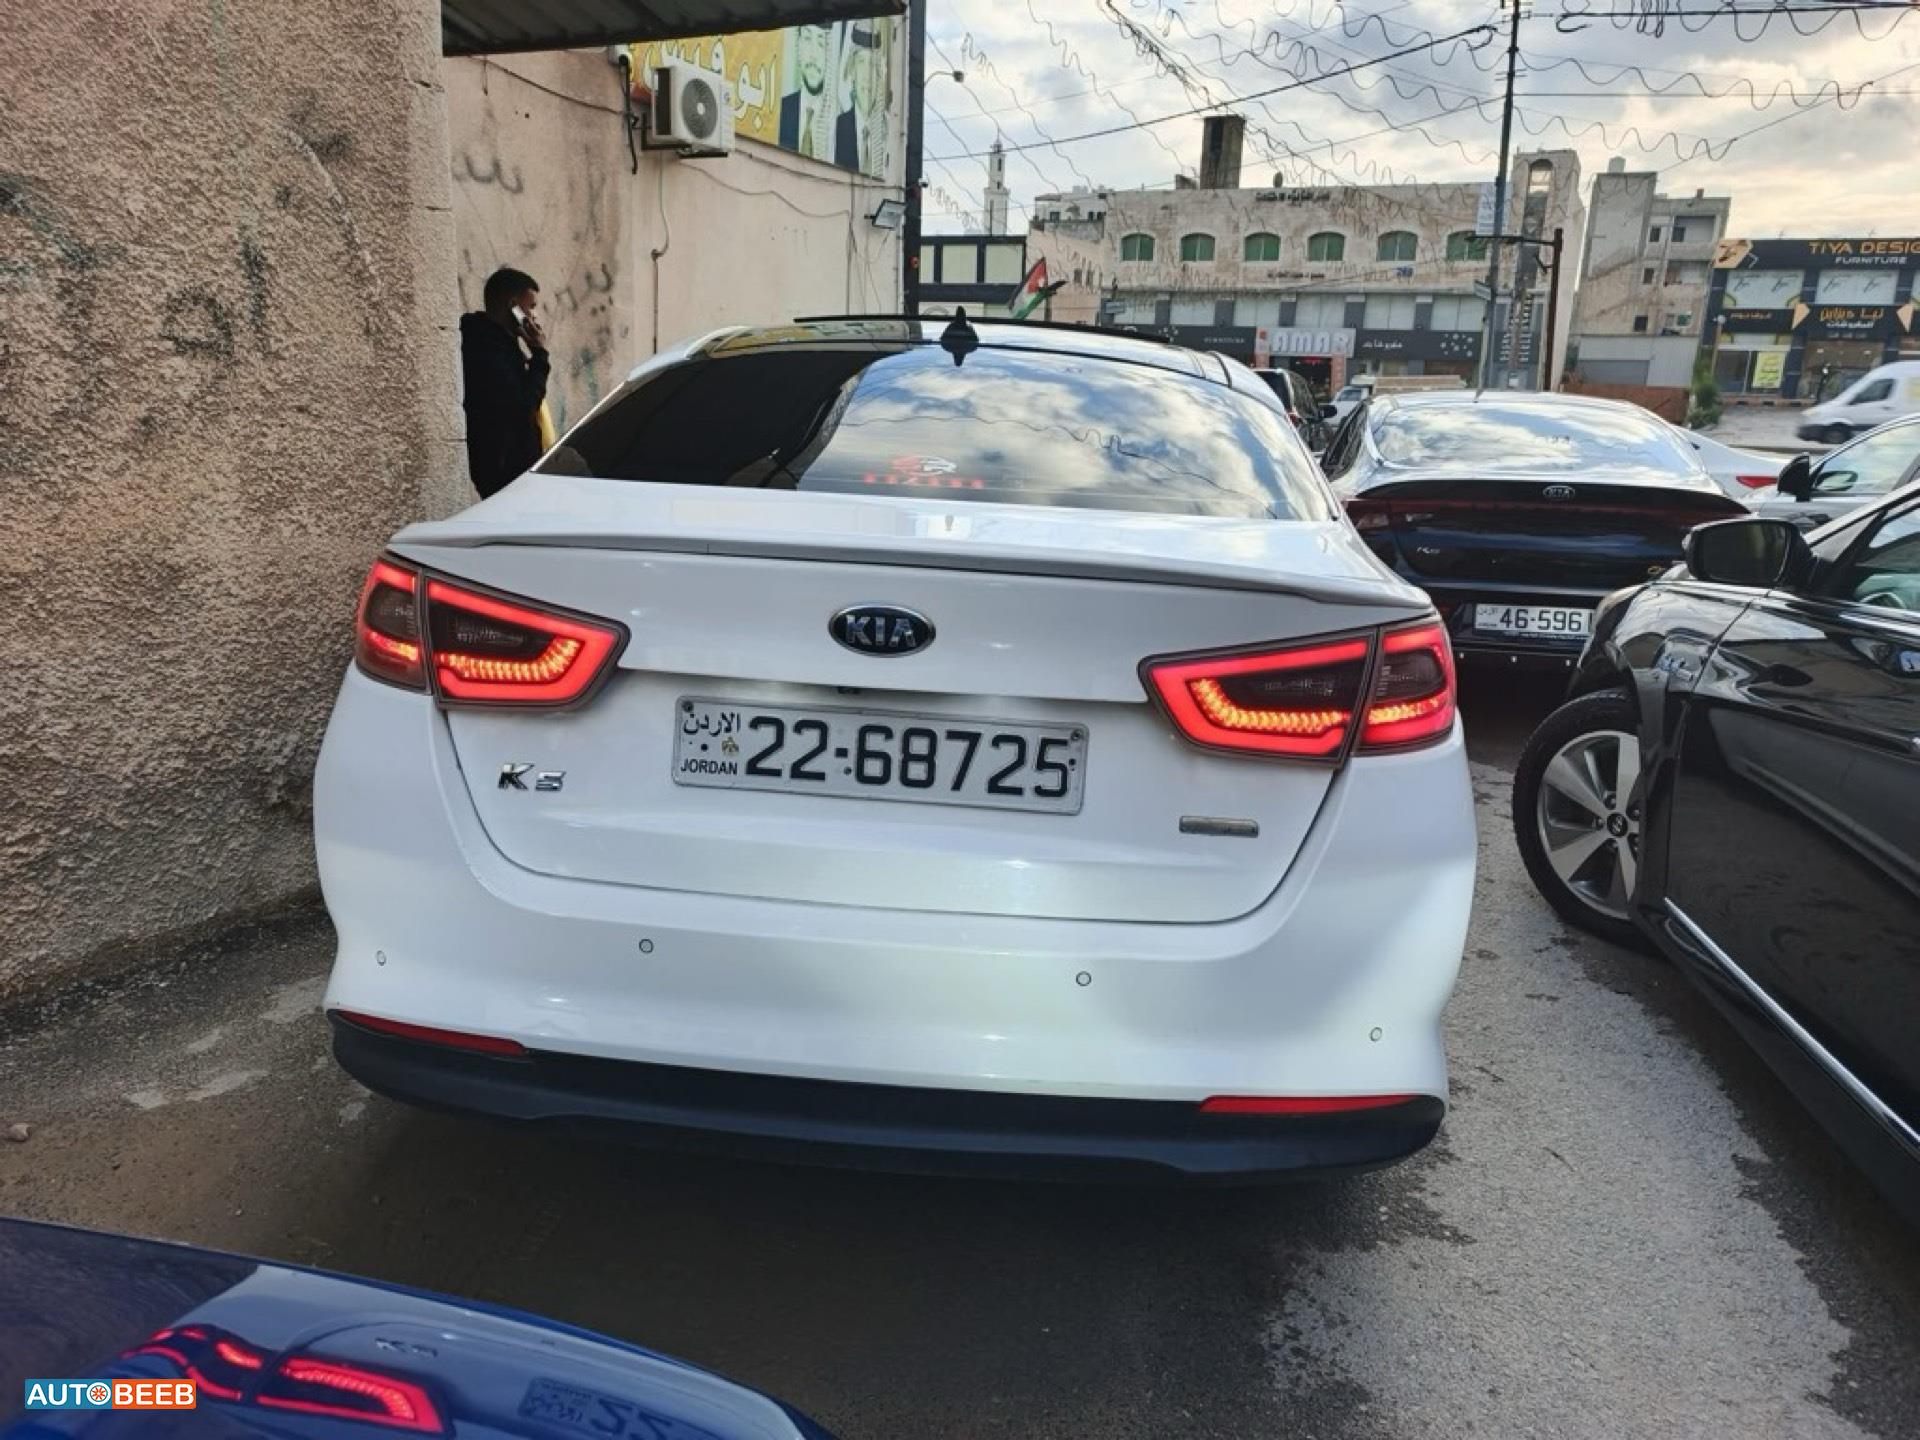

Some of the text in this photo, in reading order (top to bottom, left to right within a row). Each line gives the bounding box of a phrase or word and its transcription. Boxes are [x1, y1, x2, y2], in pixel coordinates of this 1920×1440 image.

[1835, 256, 1908, 265] FURNITURE
[844, 615, 919, 648] KIA
[683, 712, 741, 738] الاردن
[680, 758, 738, 777] JORDAN
[745, 715, 1070, 799] 22-68725
[498, 762, 567, 792] K5
